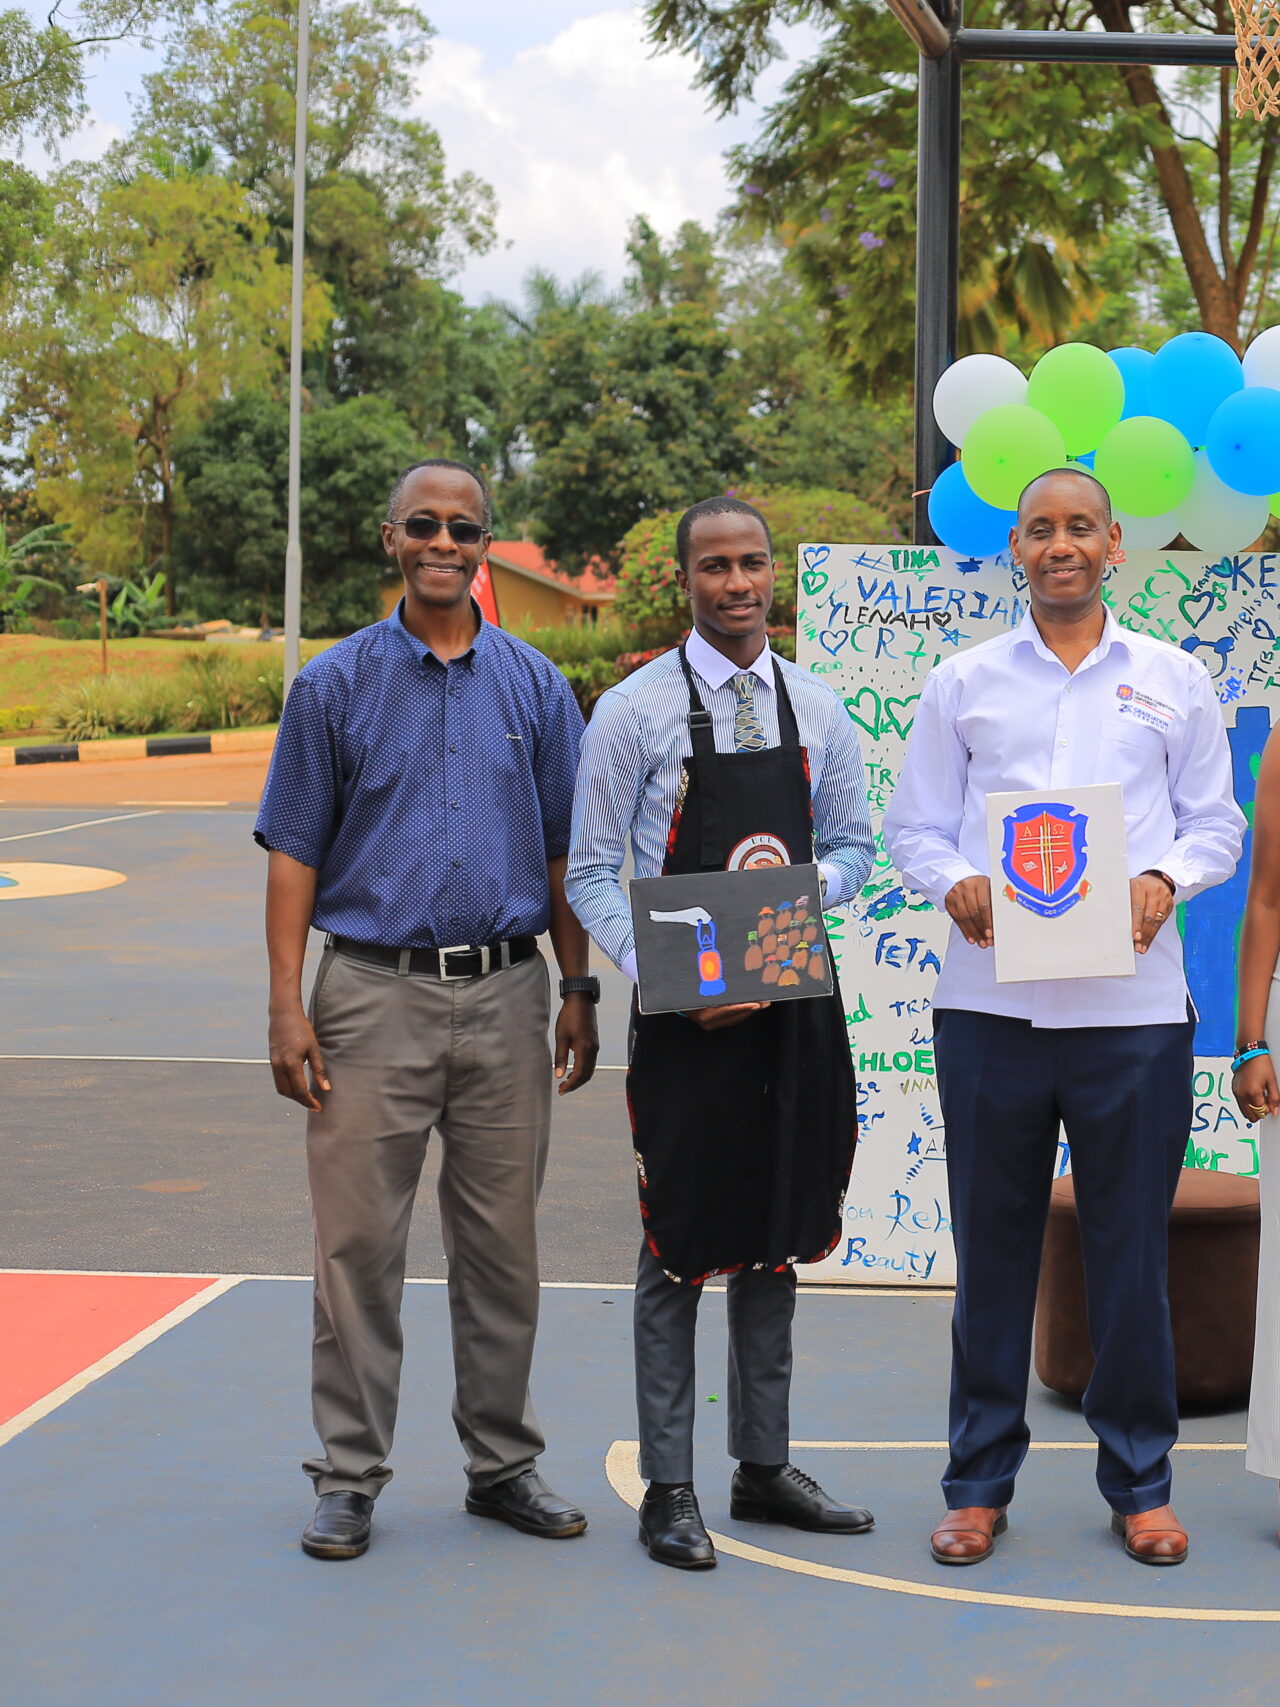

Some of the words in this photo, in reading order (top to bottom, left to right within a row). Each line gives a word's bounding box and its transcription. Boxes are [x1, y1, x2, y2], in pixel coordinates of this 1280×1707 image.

[844, 606, 930, 630] LENAH
[751, 837, 773, 845] UCU
[841, 1237, 937, 1280] Beauty
